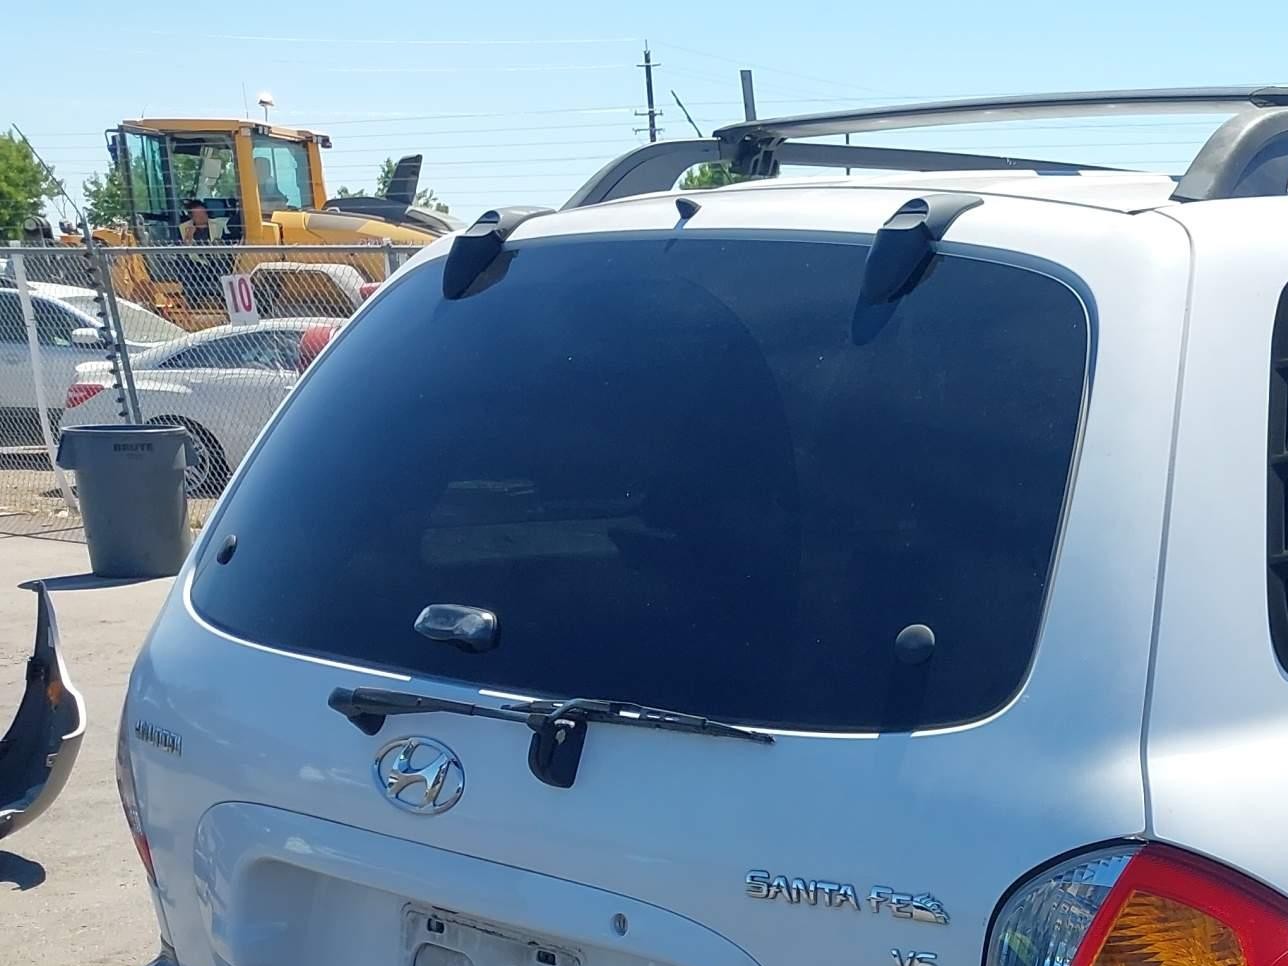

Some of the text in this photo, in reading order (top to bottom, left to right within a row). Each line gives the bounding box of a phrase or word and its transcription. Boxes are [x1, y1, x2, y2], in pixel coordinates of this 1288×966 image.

[229, 277, 252, 313] 10
[745, 869, 914, 919] SANTA FE
